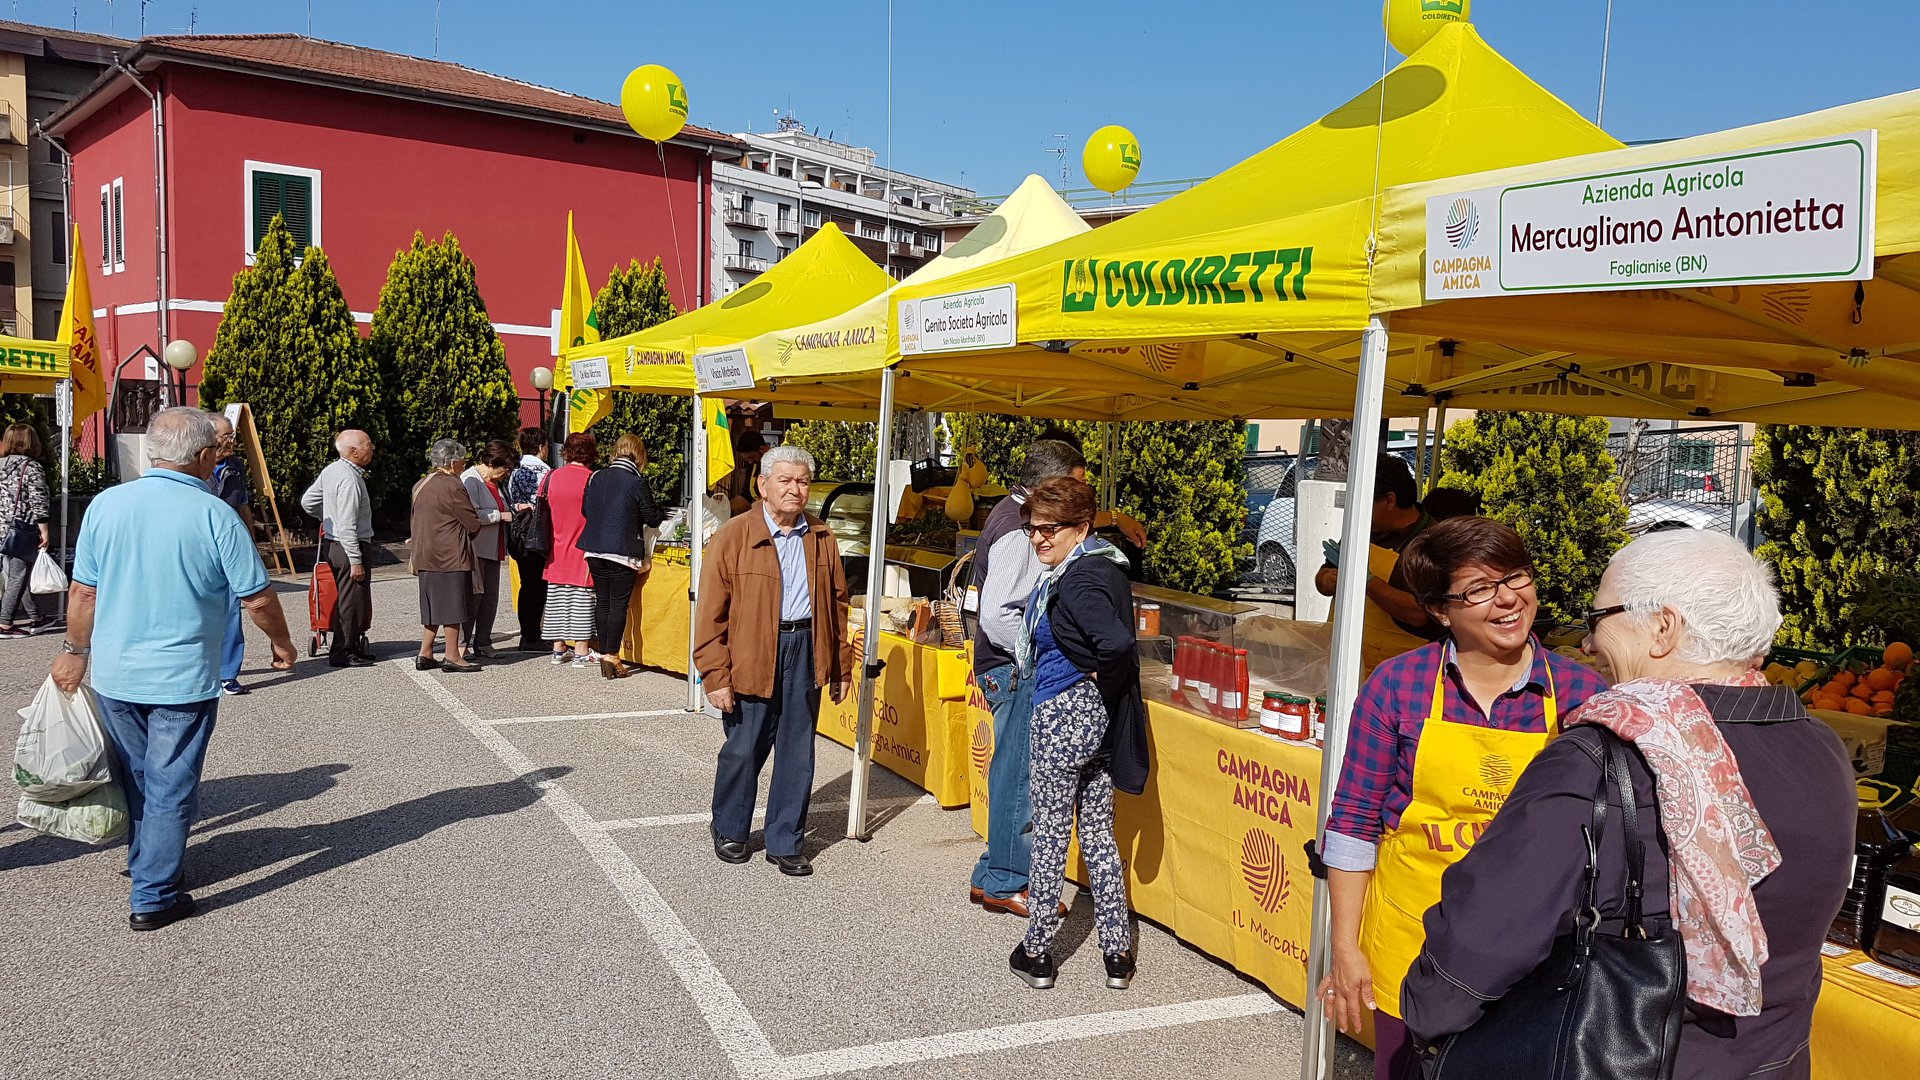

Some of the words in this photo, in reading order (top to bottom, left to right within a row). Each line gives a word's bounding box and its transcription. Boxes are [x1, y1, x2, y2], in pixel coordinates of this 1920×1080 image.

[1581, 178, 1654, 205] Azienda
[1662, 165, 1744, 197] Agricola
[1511, 215, 1663, 253] Mercugliano
[1671, 198, 1845, 241] Antonietta
[1103, 246, 1314, 308] COLDIRETTI
[1433, 255, 1492, 274] CAMPAGNA
[1610, 257, 1671, 278] Foglianise
[1675, 254, 1708, 275] (BN)
[1441, 273, 1481, 291] AMICA
[943, 299, 962, 310] Azienda
[964, 295, 985, 309] Agricola
[924, 318, 946, 333] Genito
[948, 314, 974, 331] Societa
[976, 309, 1008, 330] Agricola
[794, 331, 840, 351] CAMPAGNA
[842, 326, 876, 345] AMICA
[637, 351, 665, 366] CAMPAGNA
[665, 351, 686, 366] AMICA
[851, 678, 899, 726] Mcato
[848, 714, 889, 753] Caagna
[891, 736, 922, 766] Amica
[1217, 749, 1312, 807] CAMPAGNA
[1232, 782, 1293, 829] AMICA
[1420, 823, 1454, 852] IL
[1250, 917, 1308, 964] Mercato
